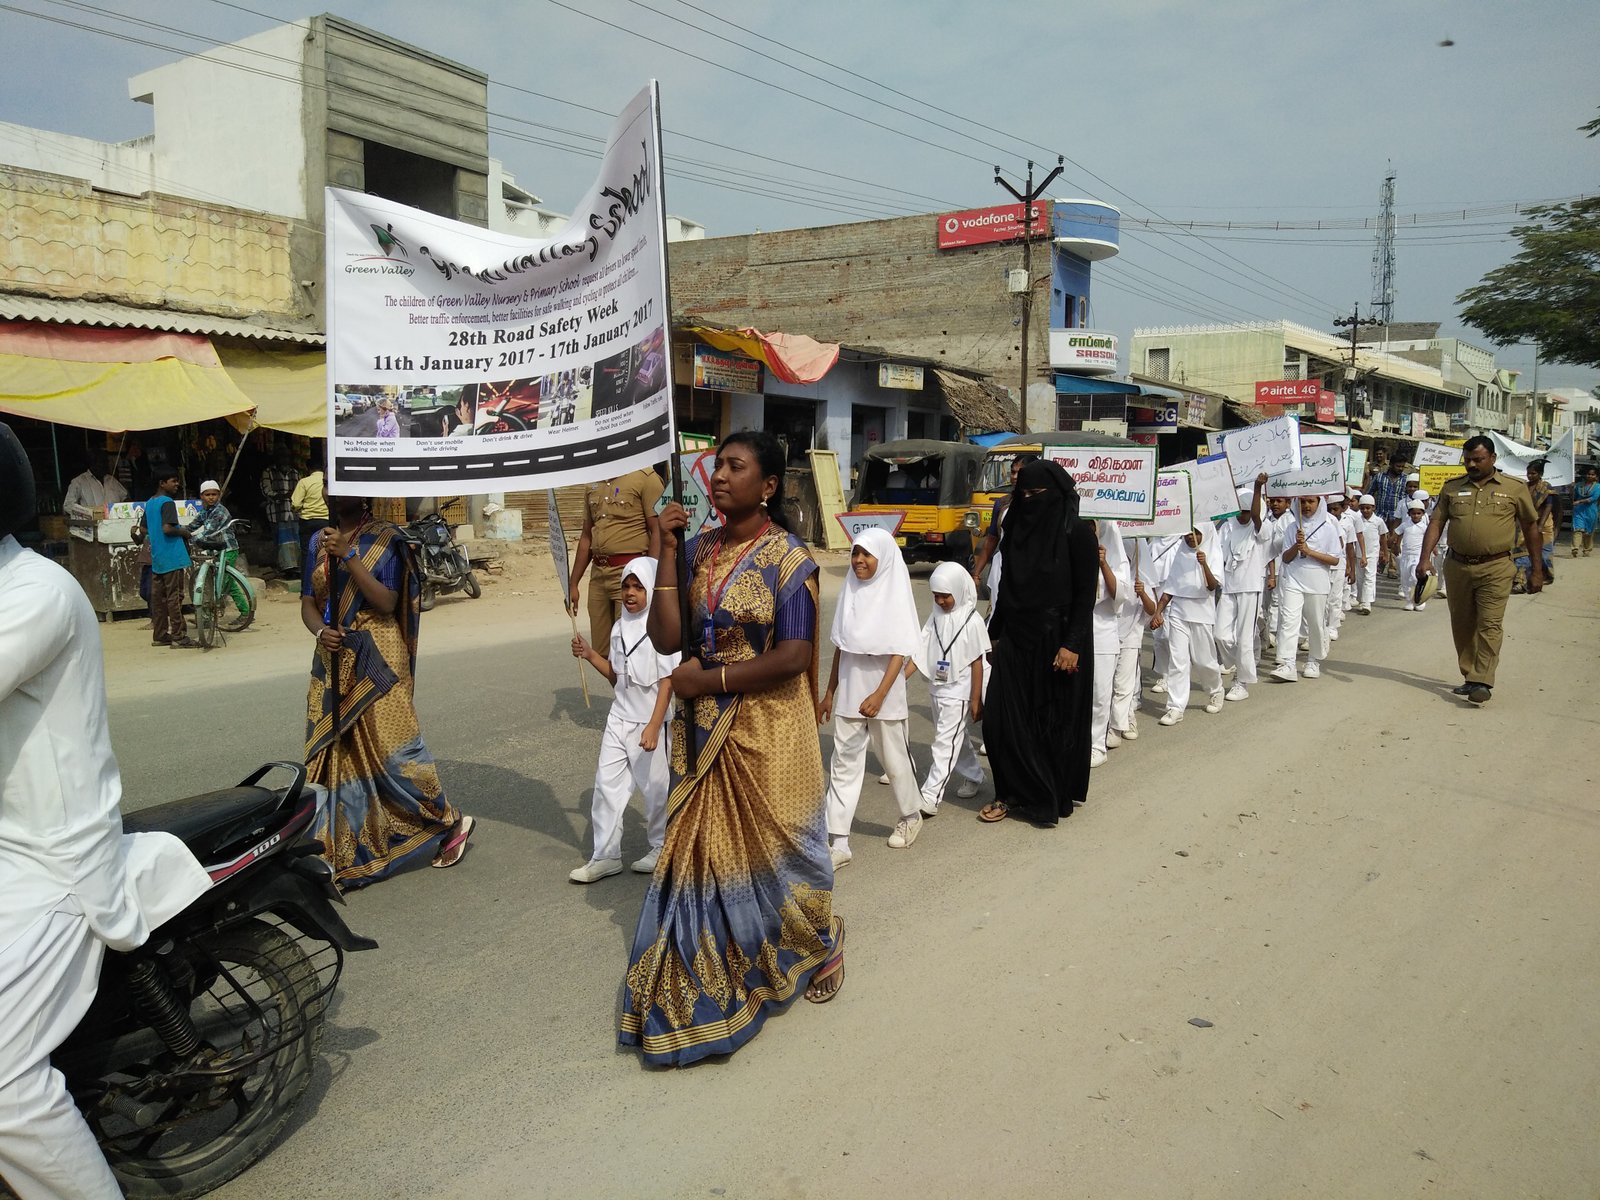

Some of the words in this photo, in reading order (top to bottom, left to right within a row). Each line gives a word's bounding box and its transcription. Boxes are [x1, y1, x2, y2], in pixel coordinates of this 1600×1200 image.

[962, 213, 1014, 228] vodafone
[344, 264, 380, 274] Green
[381, 265, 415, 277] Valley
[385, 295, 397, 307] The
[399, 296, 425, 307] children
[428, 295, 436, 307] of
[436, 294, 463, 309] Green
[464, 293, 491, 309] Valley
[492, 293, 522, 307] Nursery
[523, 289, 529, 302] &
[530, 286, 558, 301] Primary
[559, 274, 580, 294] School
[582, 272, 598, 287] request
[409, 313, 428, 325] Better
[430, 313, 450, 325] traffic
[451, 310, 491, 325] enforcement,
[492, 311, 509, 323] better
[510, 306, 533, 320] facilities
[534, 305, 542, 317] for
[542, 302, 552, 315] safe
[553, 297, 572, 311] walking
[572, 293, 581, 306] and
[583, 289, 598, 306] cycling
[598, 288, 603, 297] to
[603, 280, 617, 298] protect
[448, 330, 488, 347] 28th
[492, 325, 534, 344] Road
[539, 315, 583, 338] Safety
[587, 298, 619, 324] Week
[374, 355, 414, 371] 11th
[420, 355, 494, 372] January
[498, 348, 535, 367] 2017
[549, 339, 579, 359] 17th
[584, 319, 631, 350] January
[633, 298, 653, 328] 2017
[1270, 385, 1297, 395] airtel
[1301, 385, 1316, 394] 4G
[610, 414, 623, 422] speed
[1155, 408, 1177, 422] 3G
[562, 425, 579, 433] Helmet
[596, 424, 610, 432] school
[619, 418, 632, 426] comes
[1088, 456, 1143, 471] விதிகளை
[1094, 489, 1146, 503] தடுப்போம்
[852, 523, 879, 535] GI
[253, 834, 281, 858] 100
